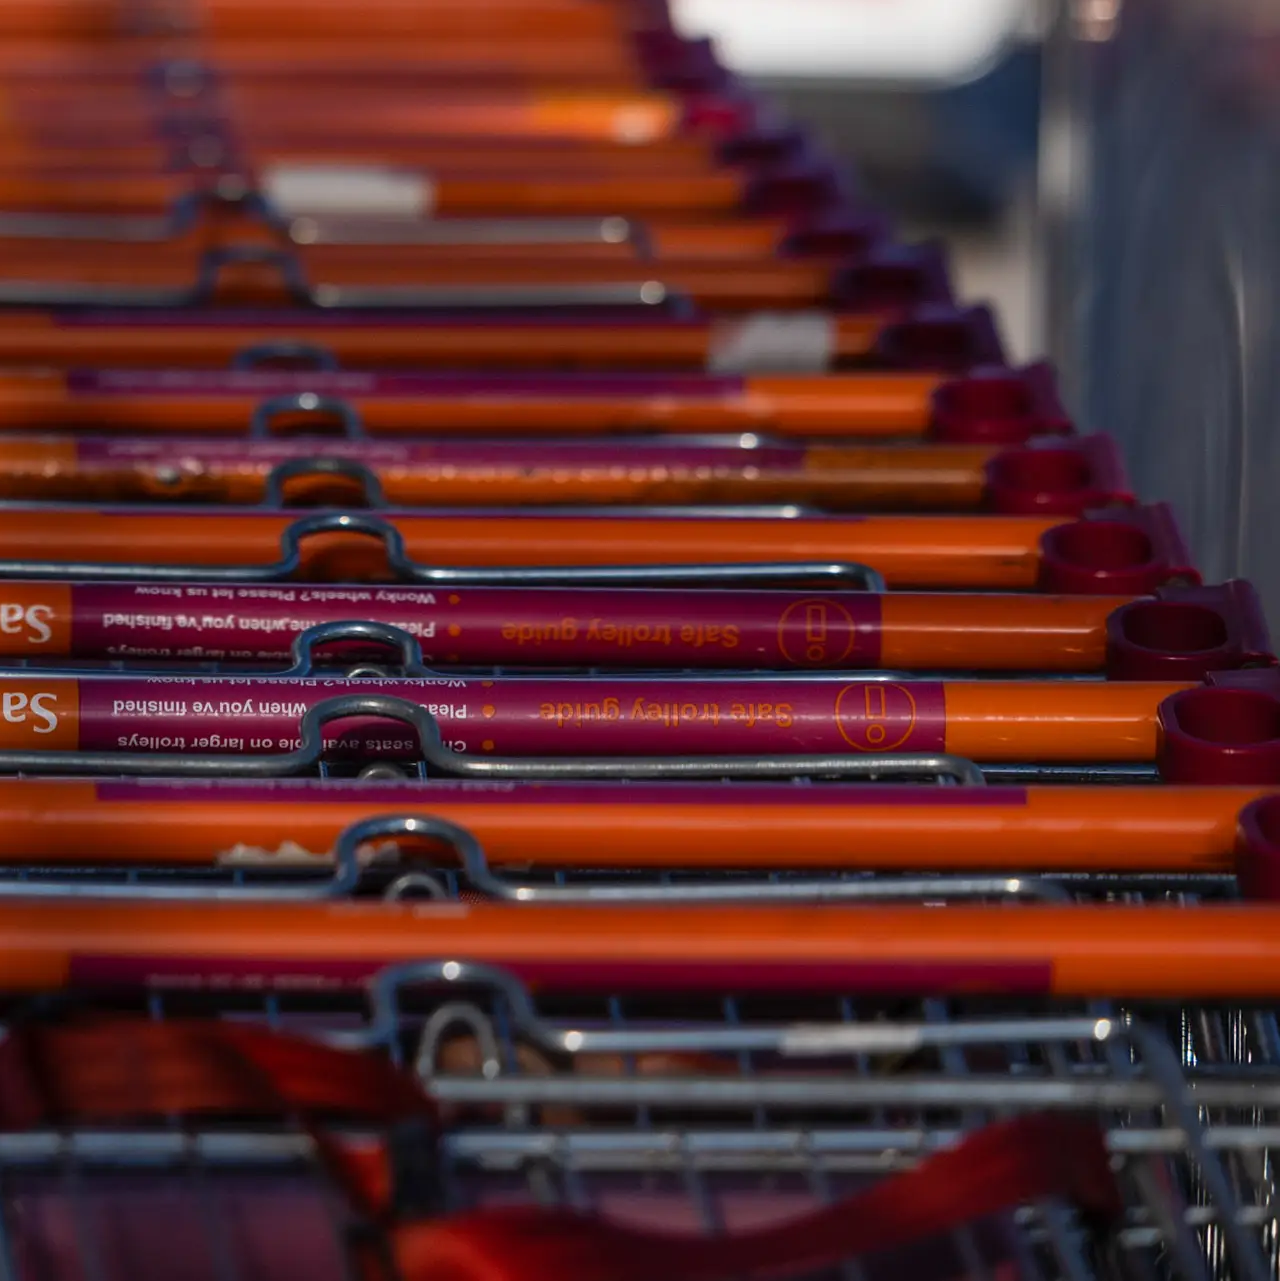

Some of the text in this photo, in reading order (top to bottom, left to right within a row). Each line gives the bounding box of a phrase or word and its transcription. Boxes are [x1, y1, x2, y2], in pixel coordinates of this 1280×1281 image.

[135, 586, 436, 604] Wonky wheels? Please let us know
[102, 613, 174, 630] finished
[177, 615, 235, 631] you've
[239, 618, 286, 632] when
[501, 618, 739, 648] Safe trolley guide
[112, 699, 467, 718] Plea when you've finished
[540, 697, 793, 728] Safe trolley guide
[117, 733, 186, 750] trolleys
[191, 734, 244, 750] larger
[250, 738, 274, 750] on
[365, 739, 414, 752] seats
